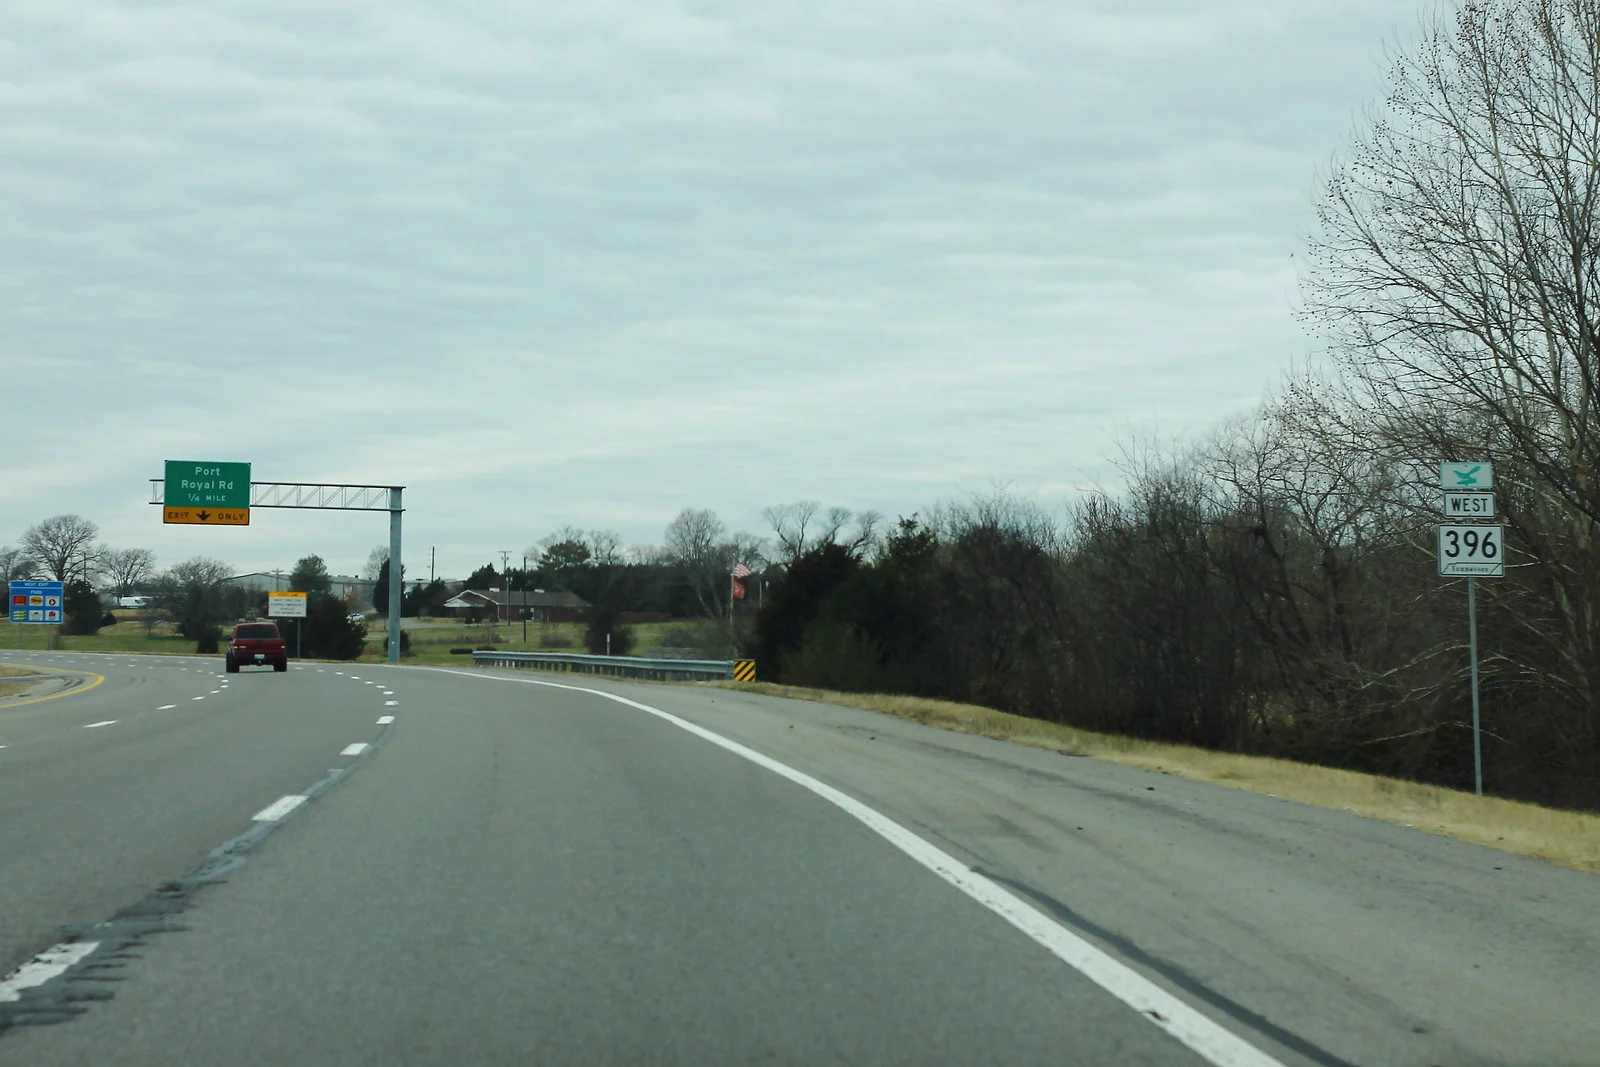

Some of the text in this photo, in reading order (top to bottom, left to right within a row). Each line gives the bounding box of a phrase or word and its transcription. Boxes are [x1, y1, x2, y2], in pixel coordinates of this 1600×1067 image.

[195, 466, 221, 476] Port
[181, 479, 233, 491] Royal Rd
[1451, 498, 1488, 512] WEST
[168, 511, 245, 520] EXIT ONLY
[1444, 530, 1497, 559] 396
